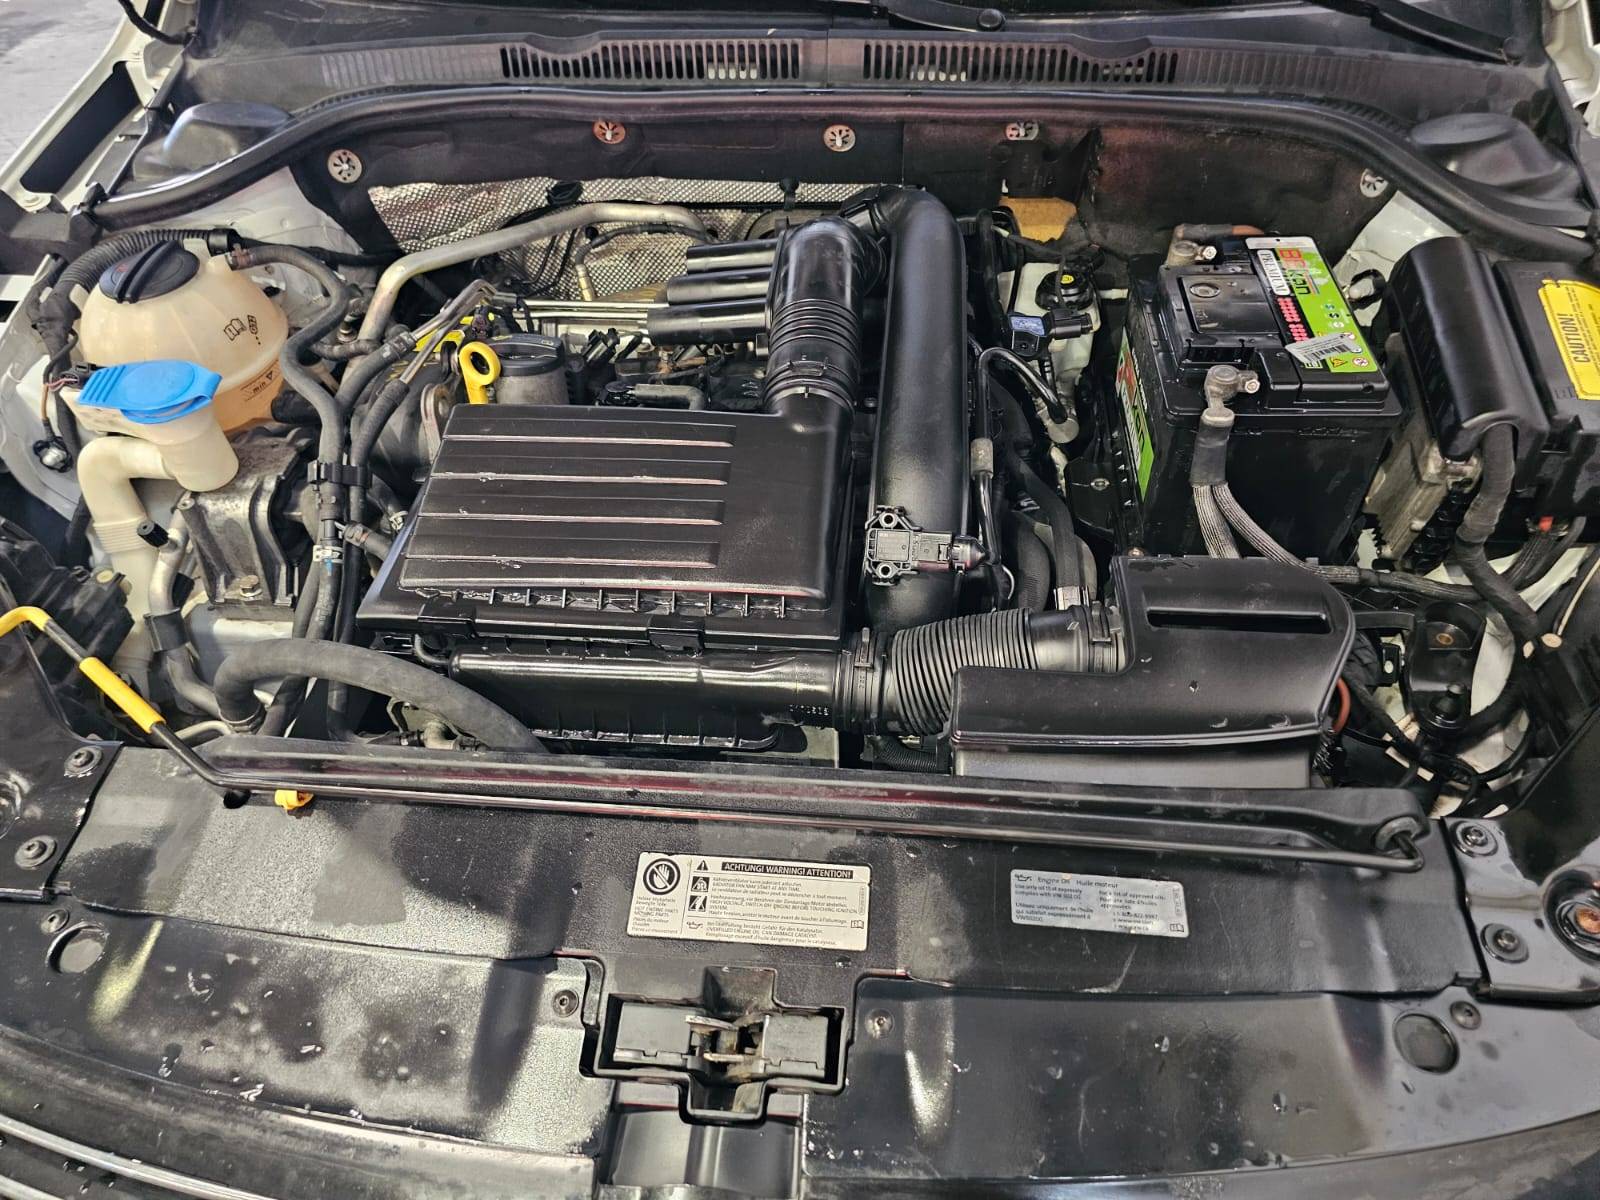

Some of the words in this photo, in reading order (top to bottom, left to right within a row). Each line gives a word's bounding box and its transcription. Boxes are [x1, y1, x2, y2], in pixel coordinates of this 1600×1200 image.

[1260, 252, 1289, 293] PREMIUM
[1557, 313, 1591, 363] CAUTION!
[725, 863, 765, 873] ACHTUNG!
[766, 866, 806, 876] WARNING!
[806, 868, 851, 878] ATTENTION!
